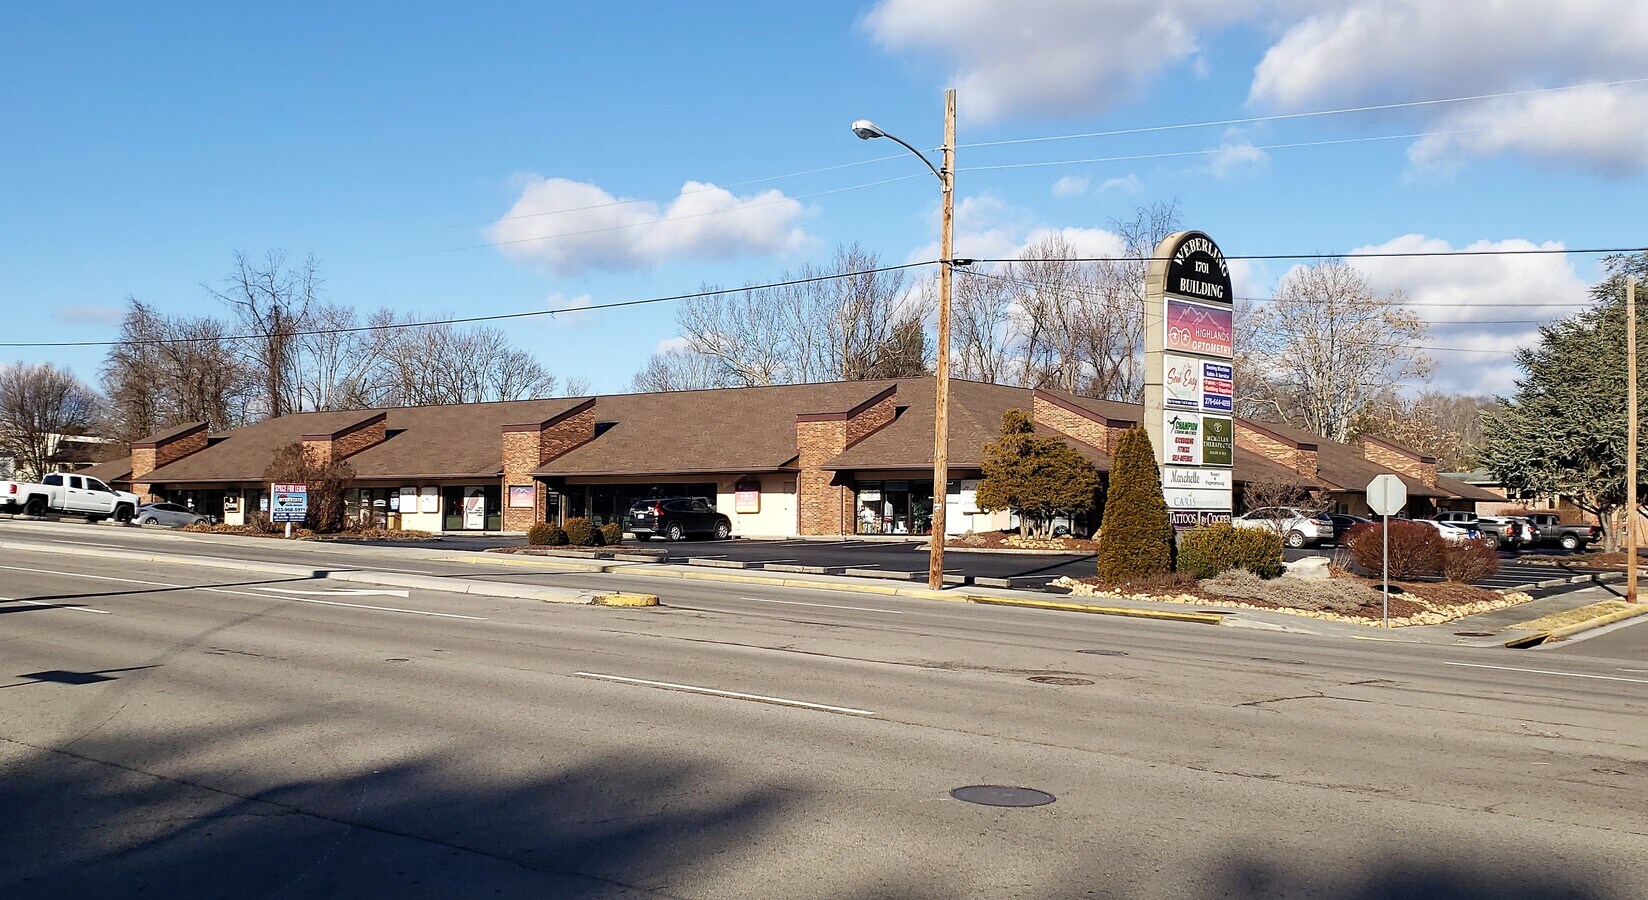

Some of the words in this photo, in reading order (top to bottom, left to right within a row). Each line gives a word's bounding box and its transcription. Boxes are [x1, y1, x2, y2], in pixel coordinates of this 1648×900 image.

[1174, 238, 1228, 277] WEBERLING
[1195, 261, 1209, 274] 1701
[1180, 278, 1224, 298] BUILDING
[1196, 327, 1230, 342] HIGHLANDS
[1192, 340, 1232, 355] OPTOMETRY
[1166, 368, 1182, 384] Sew
[1183, 369, 1198, 391] Easy
[1176, 420, 1198, 431] CHAMPION
[1174, 496, 1196, 506] CARIS
